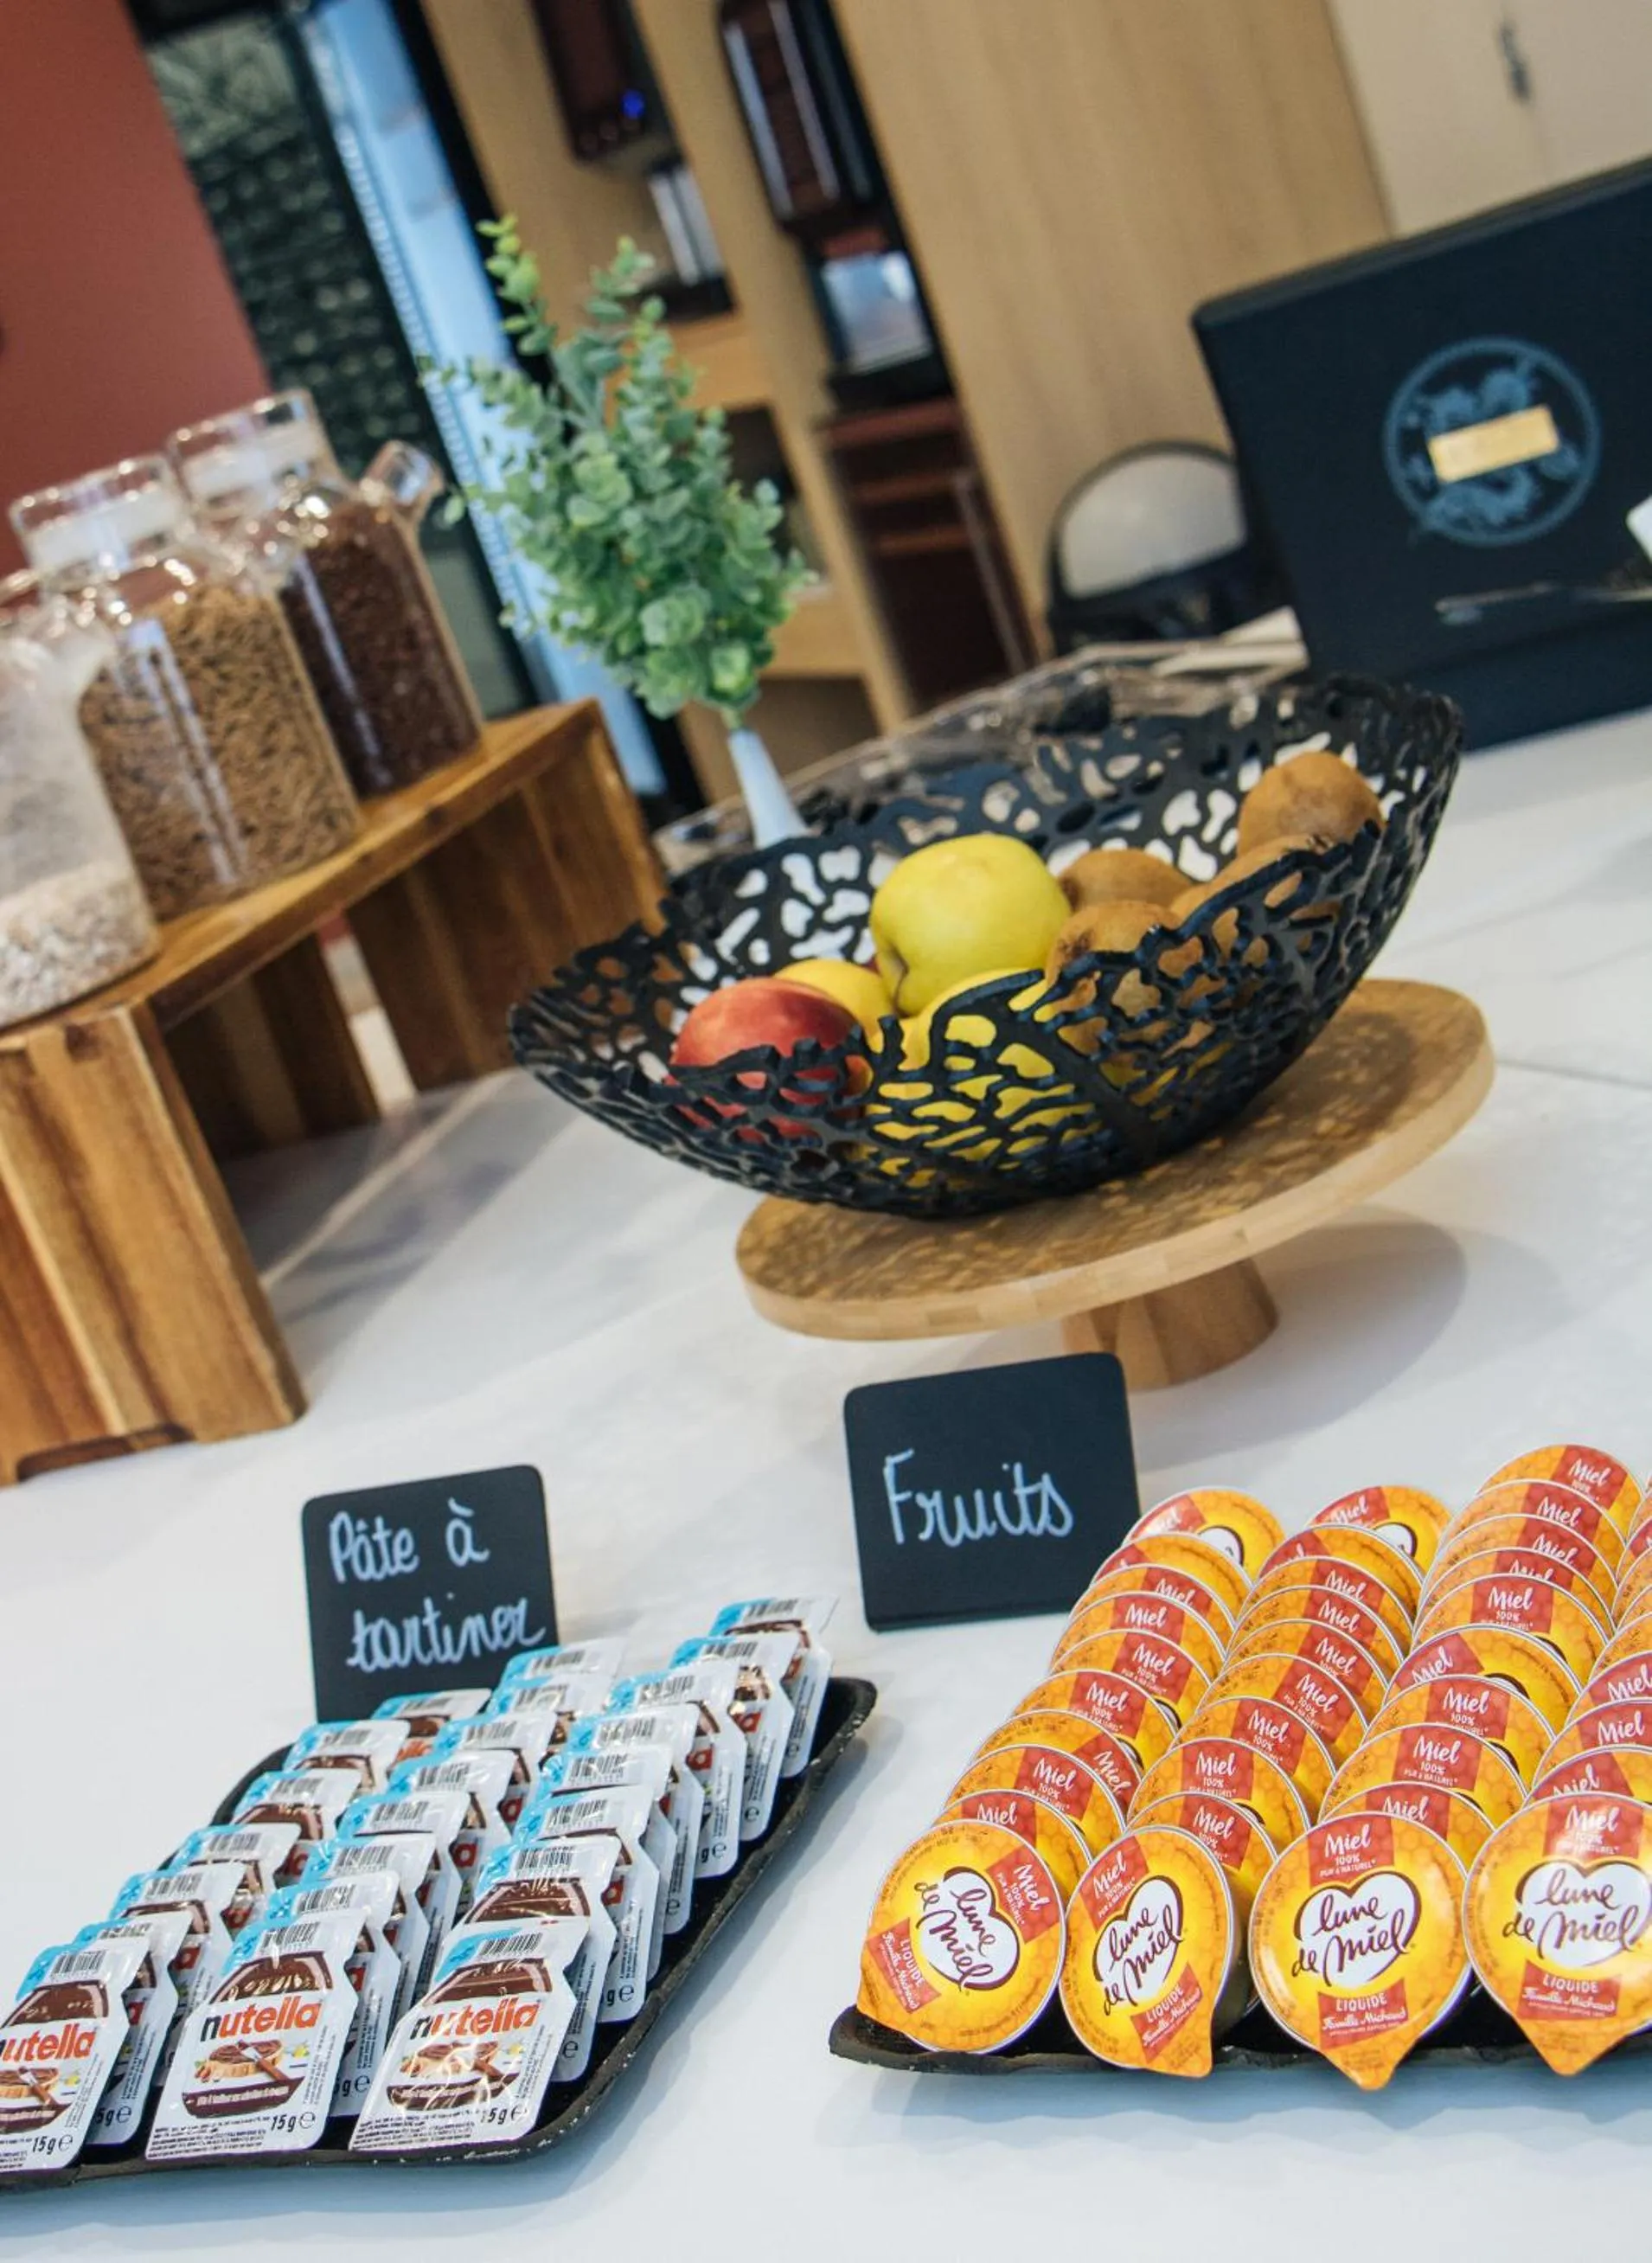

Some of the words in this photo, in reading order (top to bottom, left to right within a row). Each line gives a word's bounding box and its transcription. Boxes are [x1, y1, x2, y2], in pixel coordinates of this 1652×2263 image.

[1568, 1458, 1611, 1486] Miel
[882, 1449, 1074, 1548] Fruits
[1537, 1497, 1582, 1528] Miel
[328, 1510, 420, 1584] Pâte
[444, 1497, 491, 1567] à
[1532, 1533, 1578, 1565] Miel
[1325, 1568, 1367, 1600] Miel
[1488, 1586, 1534, 1611] Miel
[1124, 1602, 1167, 1628] Miel
[1318, 1598, 1361, 1633] Miel
[1495, 1610, 1521, 1622] 100%
[345, 1591, 547, 1673] tartiner
[1132, 1643, 1176, 1675] Miel
[1315, 1636, 1358, 1676] Miel
[1412, 1645, 1454, 1683] Miel
[1137, 1666, 1159, 1683] 100%
[1607, 1664, 1652, 1702] Miel
[1085, 1681, 1130, 1713] Miel
[1296, 1672, 1340, 1714] Miel
[1297, 1696, 1318, 1717] 100%
[1443, 1687, 1490, 1715] Miel
[1247, 1708, 1290, 1743] Miel
[1450, 1713, 1476, 1725] 100%
[1598, 1709, 1646, 1746] Miel
[1195, 1750, 1238, 1776] Miel
[1412, 1734, 1462, 1765] Miel
[1033, 1757, 1077, 1792] Miel
[1092, 1749, 1132, 1795] Miel
[1202, 1776, 1225, 1788] 100%
[1419, 1761, 1446, 1774] 100%
[1038, 1783, 1060, 1800] 100%
[976, 1801, 1019, 1827] Miel
[1193, 1805, 1235, 1839] Miel
[1383, 1795, 1430, 1823] Miel
[1565, 1804, 1620, 1833] Miel
[1324, 1823, 1372, 1858] Miel
[1092, 1850, 1129, 1900] Miel
[1335, 1854, 1361, 1866] 100%
[913, 1882, 941, 1912] de
[1013, 1863, 1051, 1912] Miel
[1534, 1869, 1621, 1910] lune
[949, 1888, 996, 1958] lune
[1312, 1894, 1388, 1936] lune
[1502, 1910, 1536, 1944] de
[1109, 1907, 1160, 1972] lune
[900, 1939, 924, 1987] LIQUIDE
[1291, 1948, 1322, 1978] de
[1104, 1982, 1125, 2016] de
[1542, 1972, 1599, 1994] LIQUIDE
[409, 1996, 541, 2040] nutella
[1145, 1984, 1185, 2024] LIQUIDE
[1335, 1992, 1388, 2012] LIQUIDE
[200, 1996, 322, 2042] nutella
